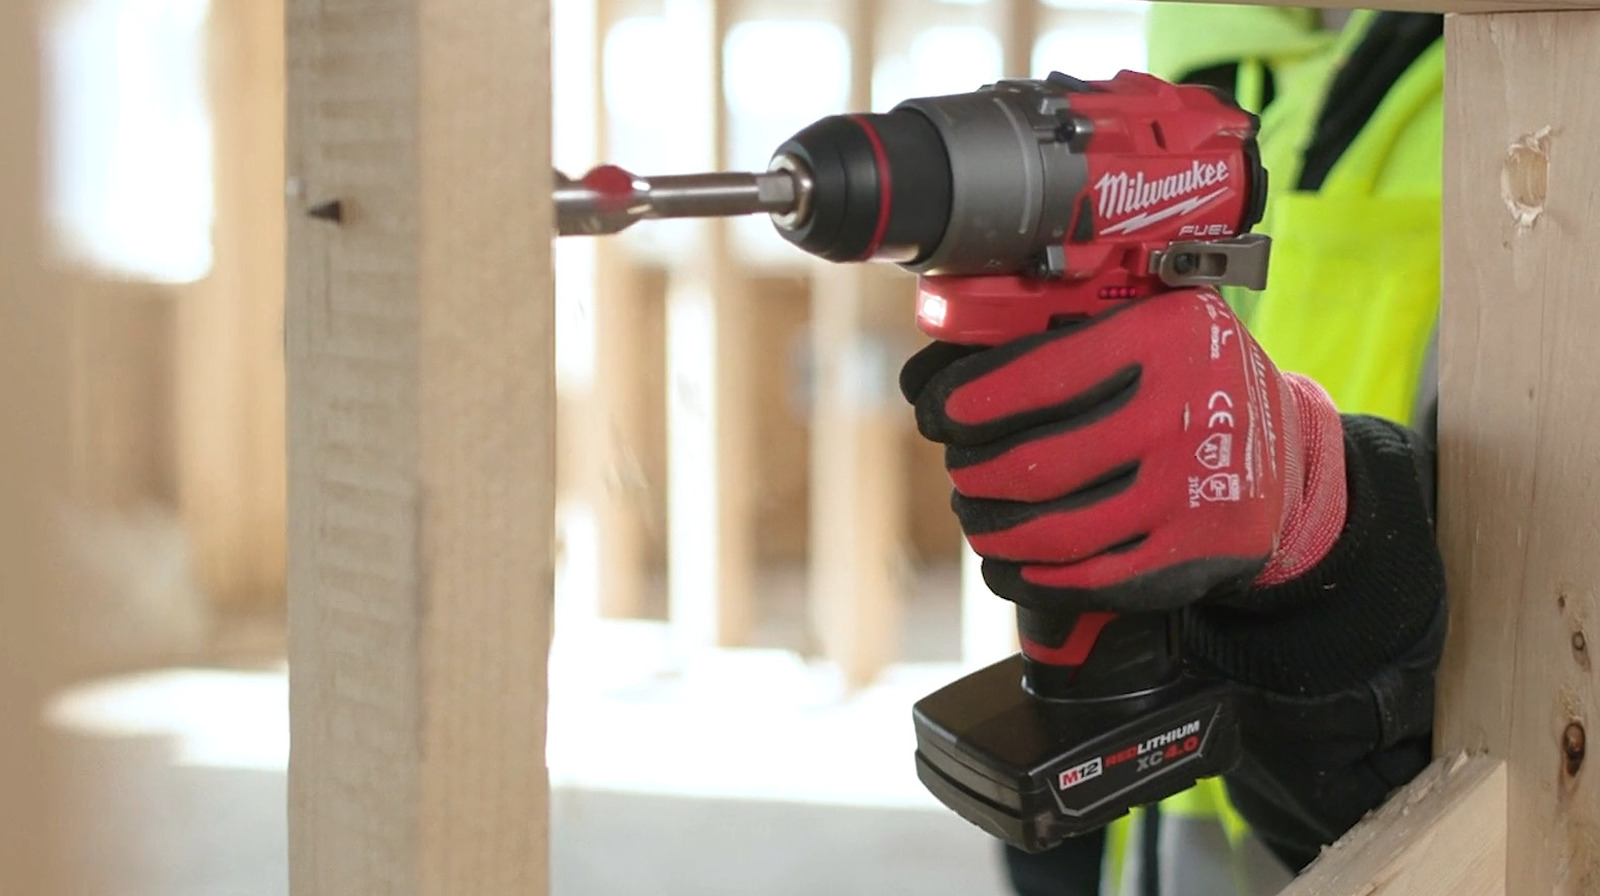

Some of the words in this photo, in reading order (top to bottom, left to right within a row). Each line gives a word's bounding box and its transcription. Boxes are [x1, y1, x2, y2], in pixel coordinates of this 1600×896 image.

[1094, 160, 1230, 219] Milwaukee
[1179, 224, 1234, 236] FUEL
[1208, 391, 1234, 428] CE
[1061, 761, 1099, 787] M12
